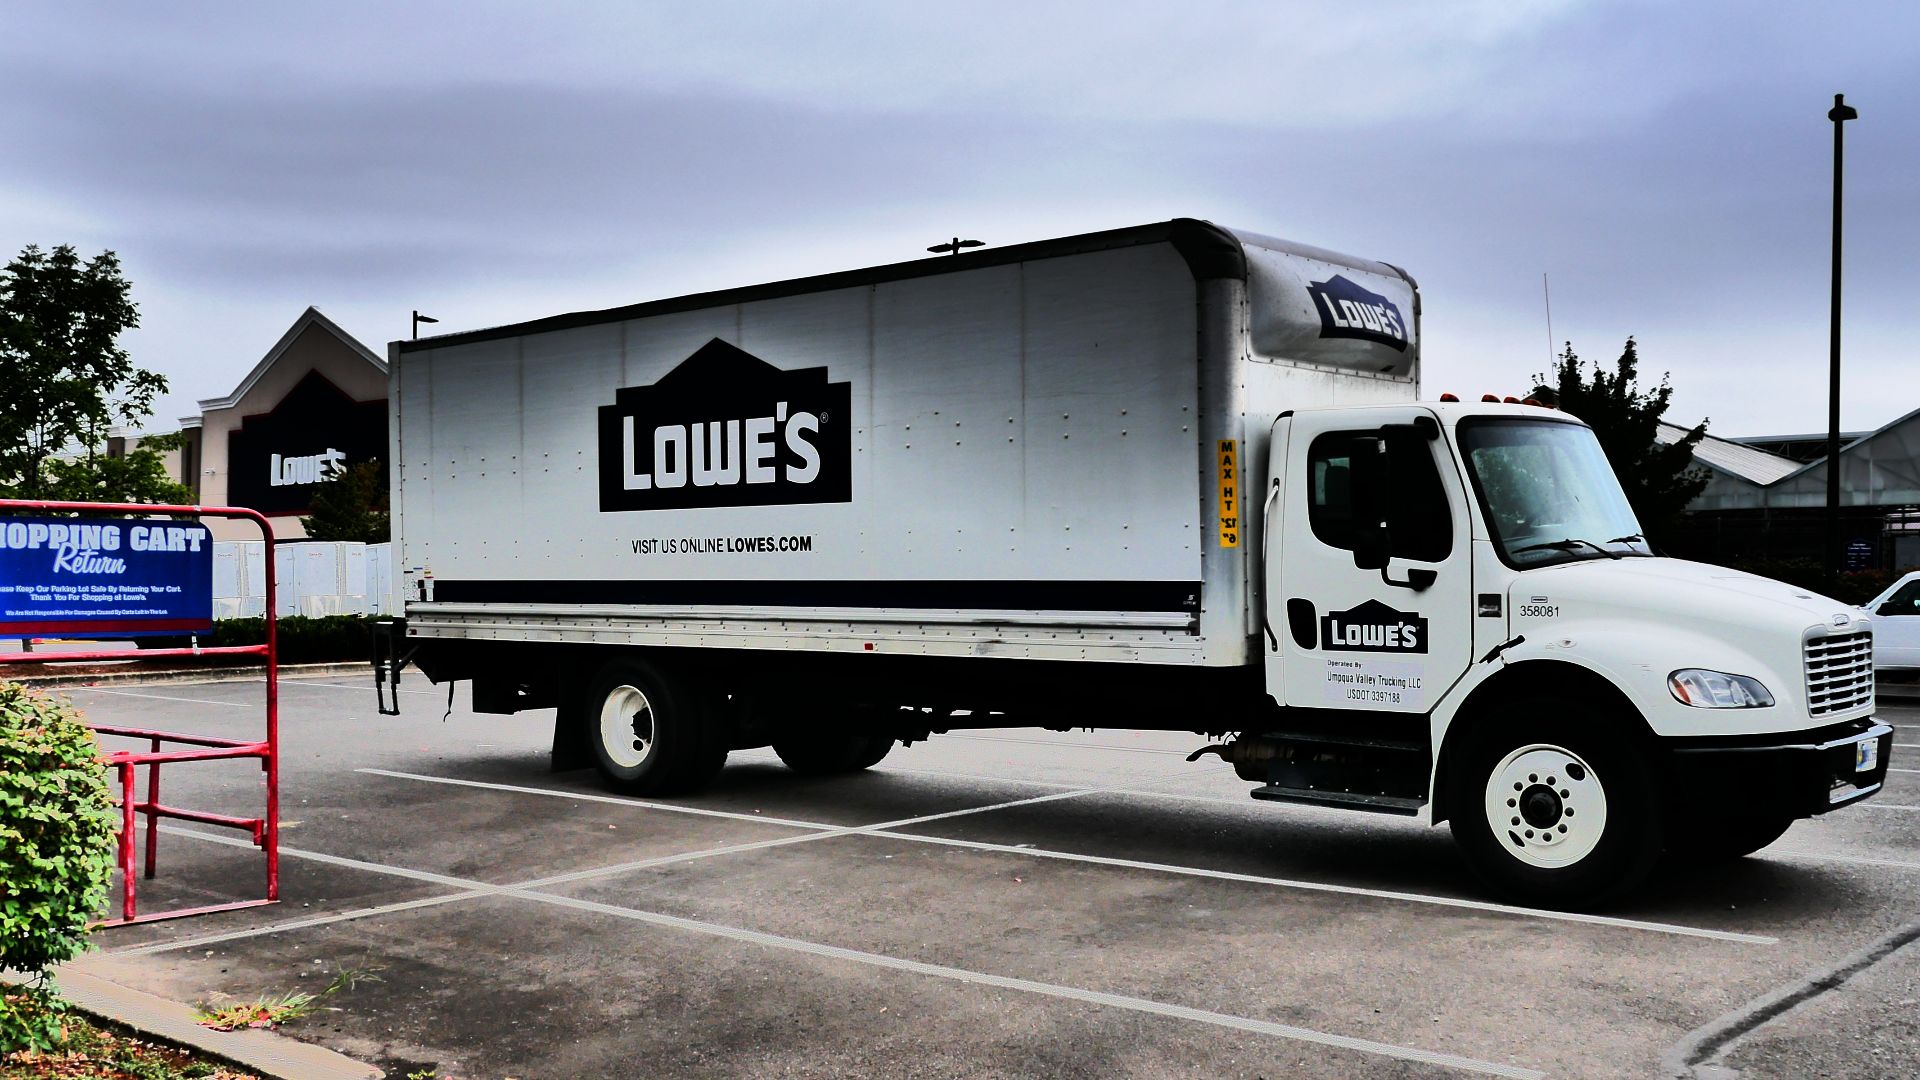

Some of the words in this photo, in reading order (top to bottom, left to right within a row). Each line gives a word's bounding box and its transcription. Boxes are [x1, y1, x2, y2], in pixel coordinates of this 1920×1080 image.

[1321, 292, 1403, 340] LOWE'S
[623, 401, 821, 490] LOWE'S
[1221, 441, 1233, 479] MAX
[1223, 487, 1233, 511] HT
[130, 526, 206, 552] CART
[632, 538, 658, 554] VISIT
[661, 539, 677, 554] US
[680, 537, 724, 553] ONLINE
[727, 536, 812, 552] LOWES.COM
[53, 541, 127, 574] Return
[15, 585, 35, 593] Keep
[108, 585, 118, 593] By
[1520, 606, 1559, 617] 358081
[1332, 620, 1417, 648] LOWE'S
[1328, 671, 1353, 684] Umpqua
[1356, 674, 1376, 687] Valley
[1378, 675, 1406, 689] Trucking
[1408, 678, 1421, 689] LLC
[1347, 689, 1369, 701] USDOT
